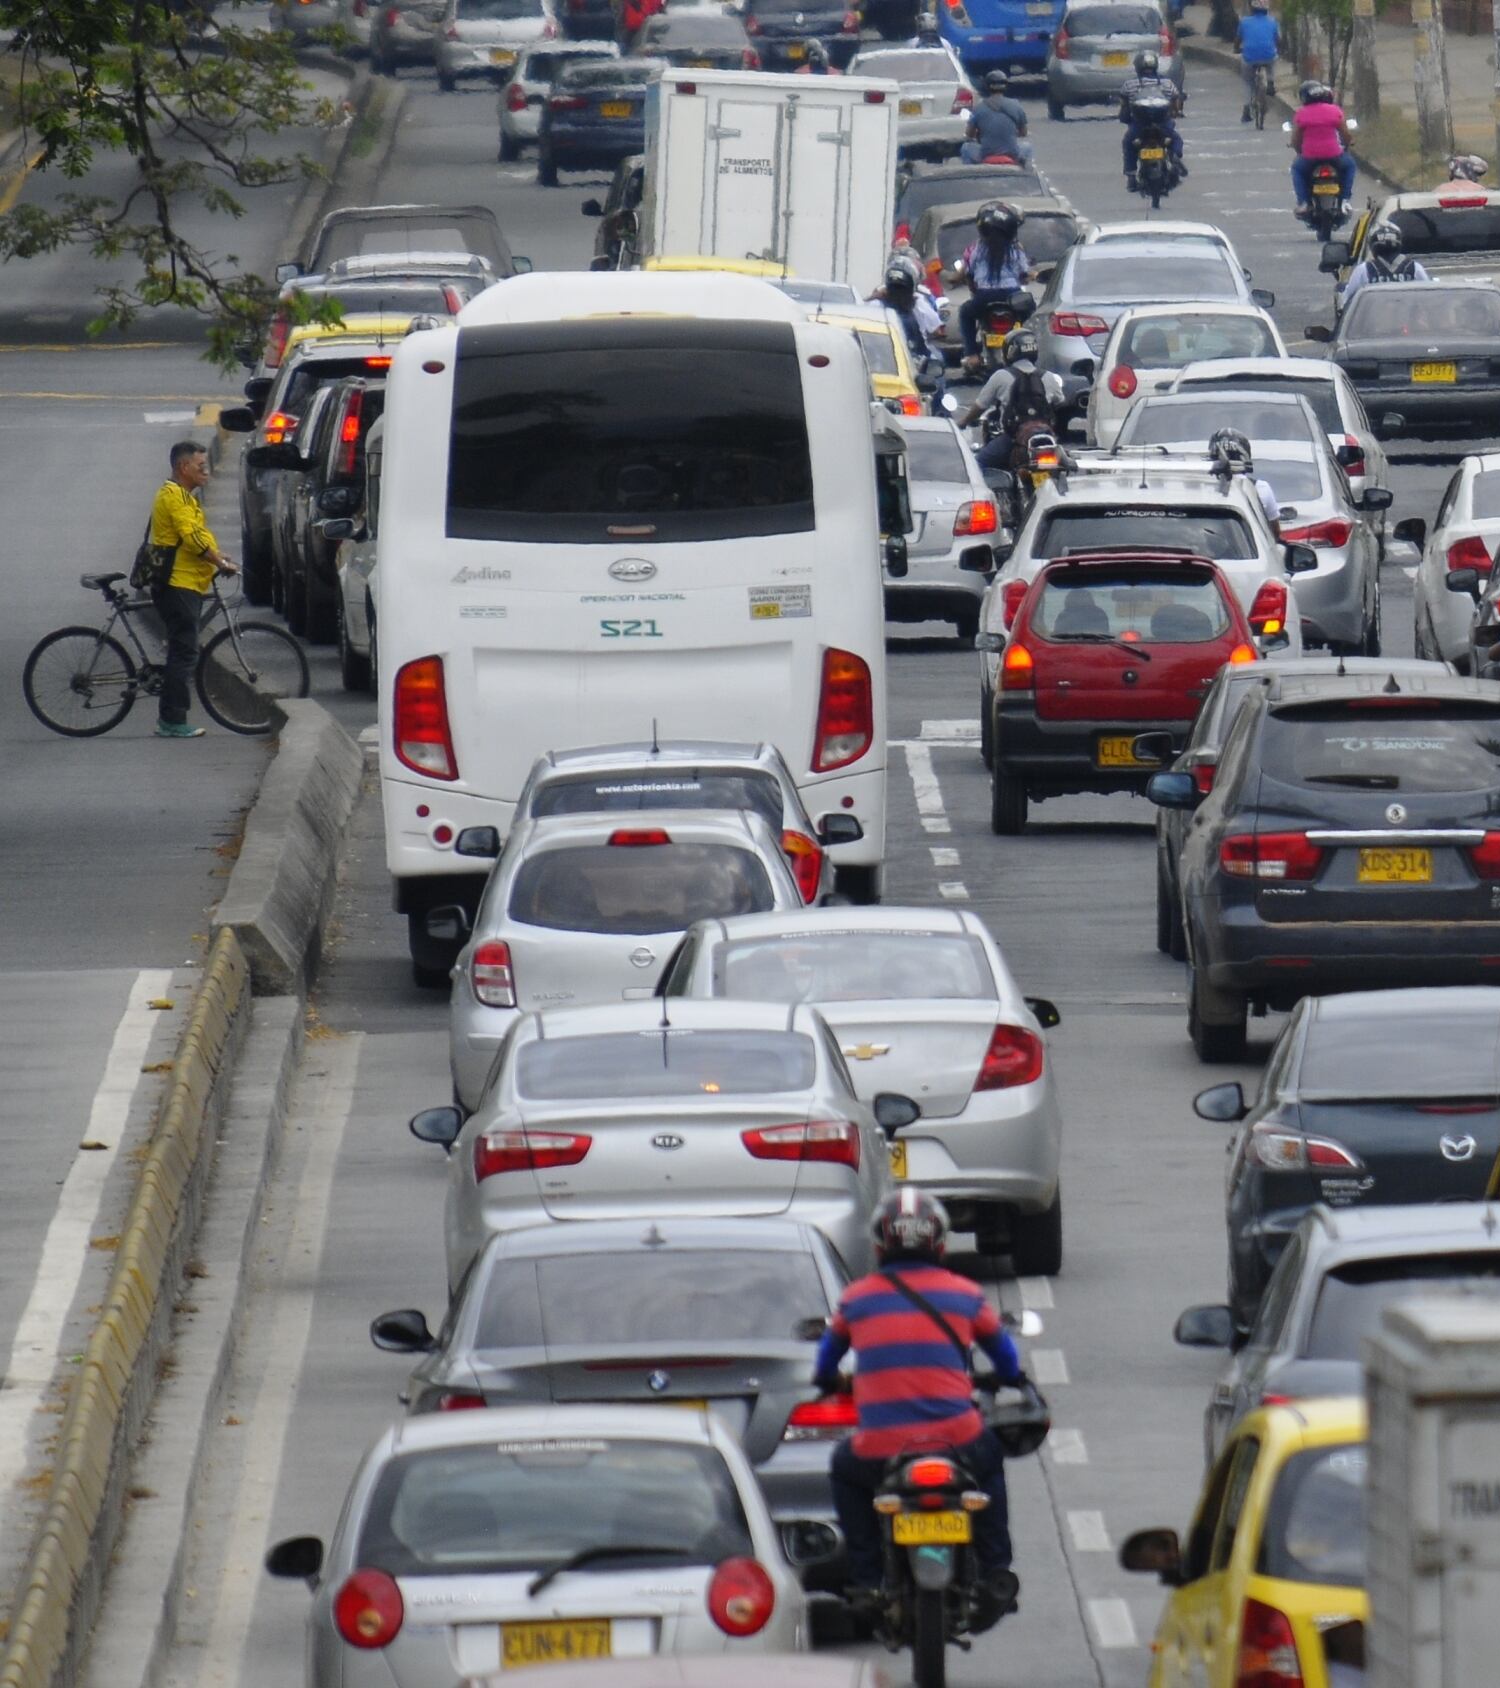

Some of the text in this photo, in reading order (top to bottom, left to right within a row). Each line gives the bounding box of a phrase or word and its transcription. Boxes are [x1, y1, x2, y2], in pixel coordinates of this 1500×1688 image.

[723, 158, 771, 168] TRANSPORTE
[734, 166, 774, 176] ALIMENTOS
[1360, 851, 1428, 872] KDS-314
